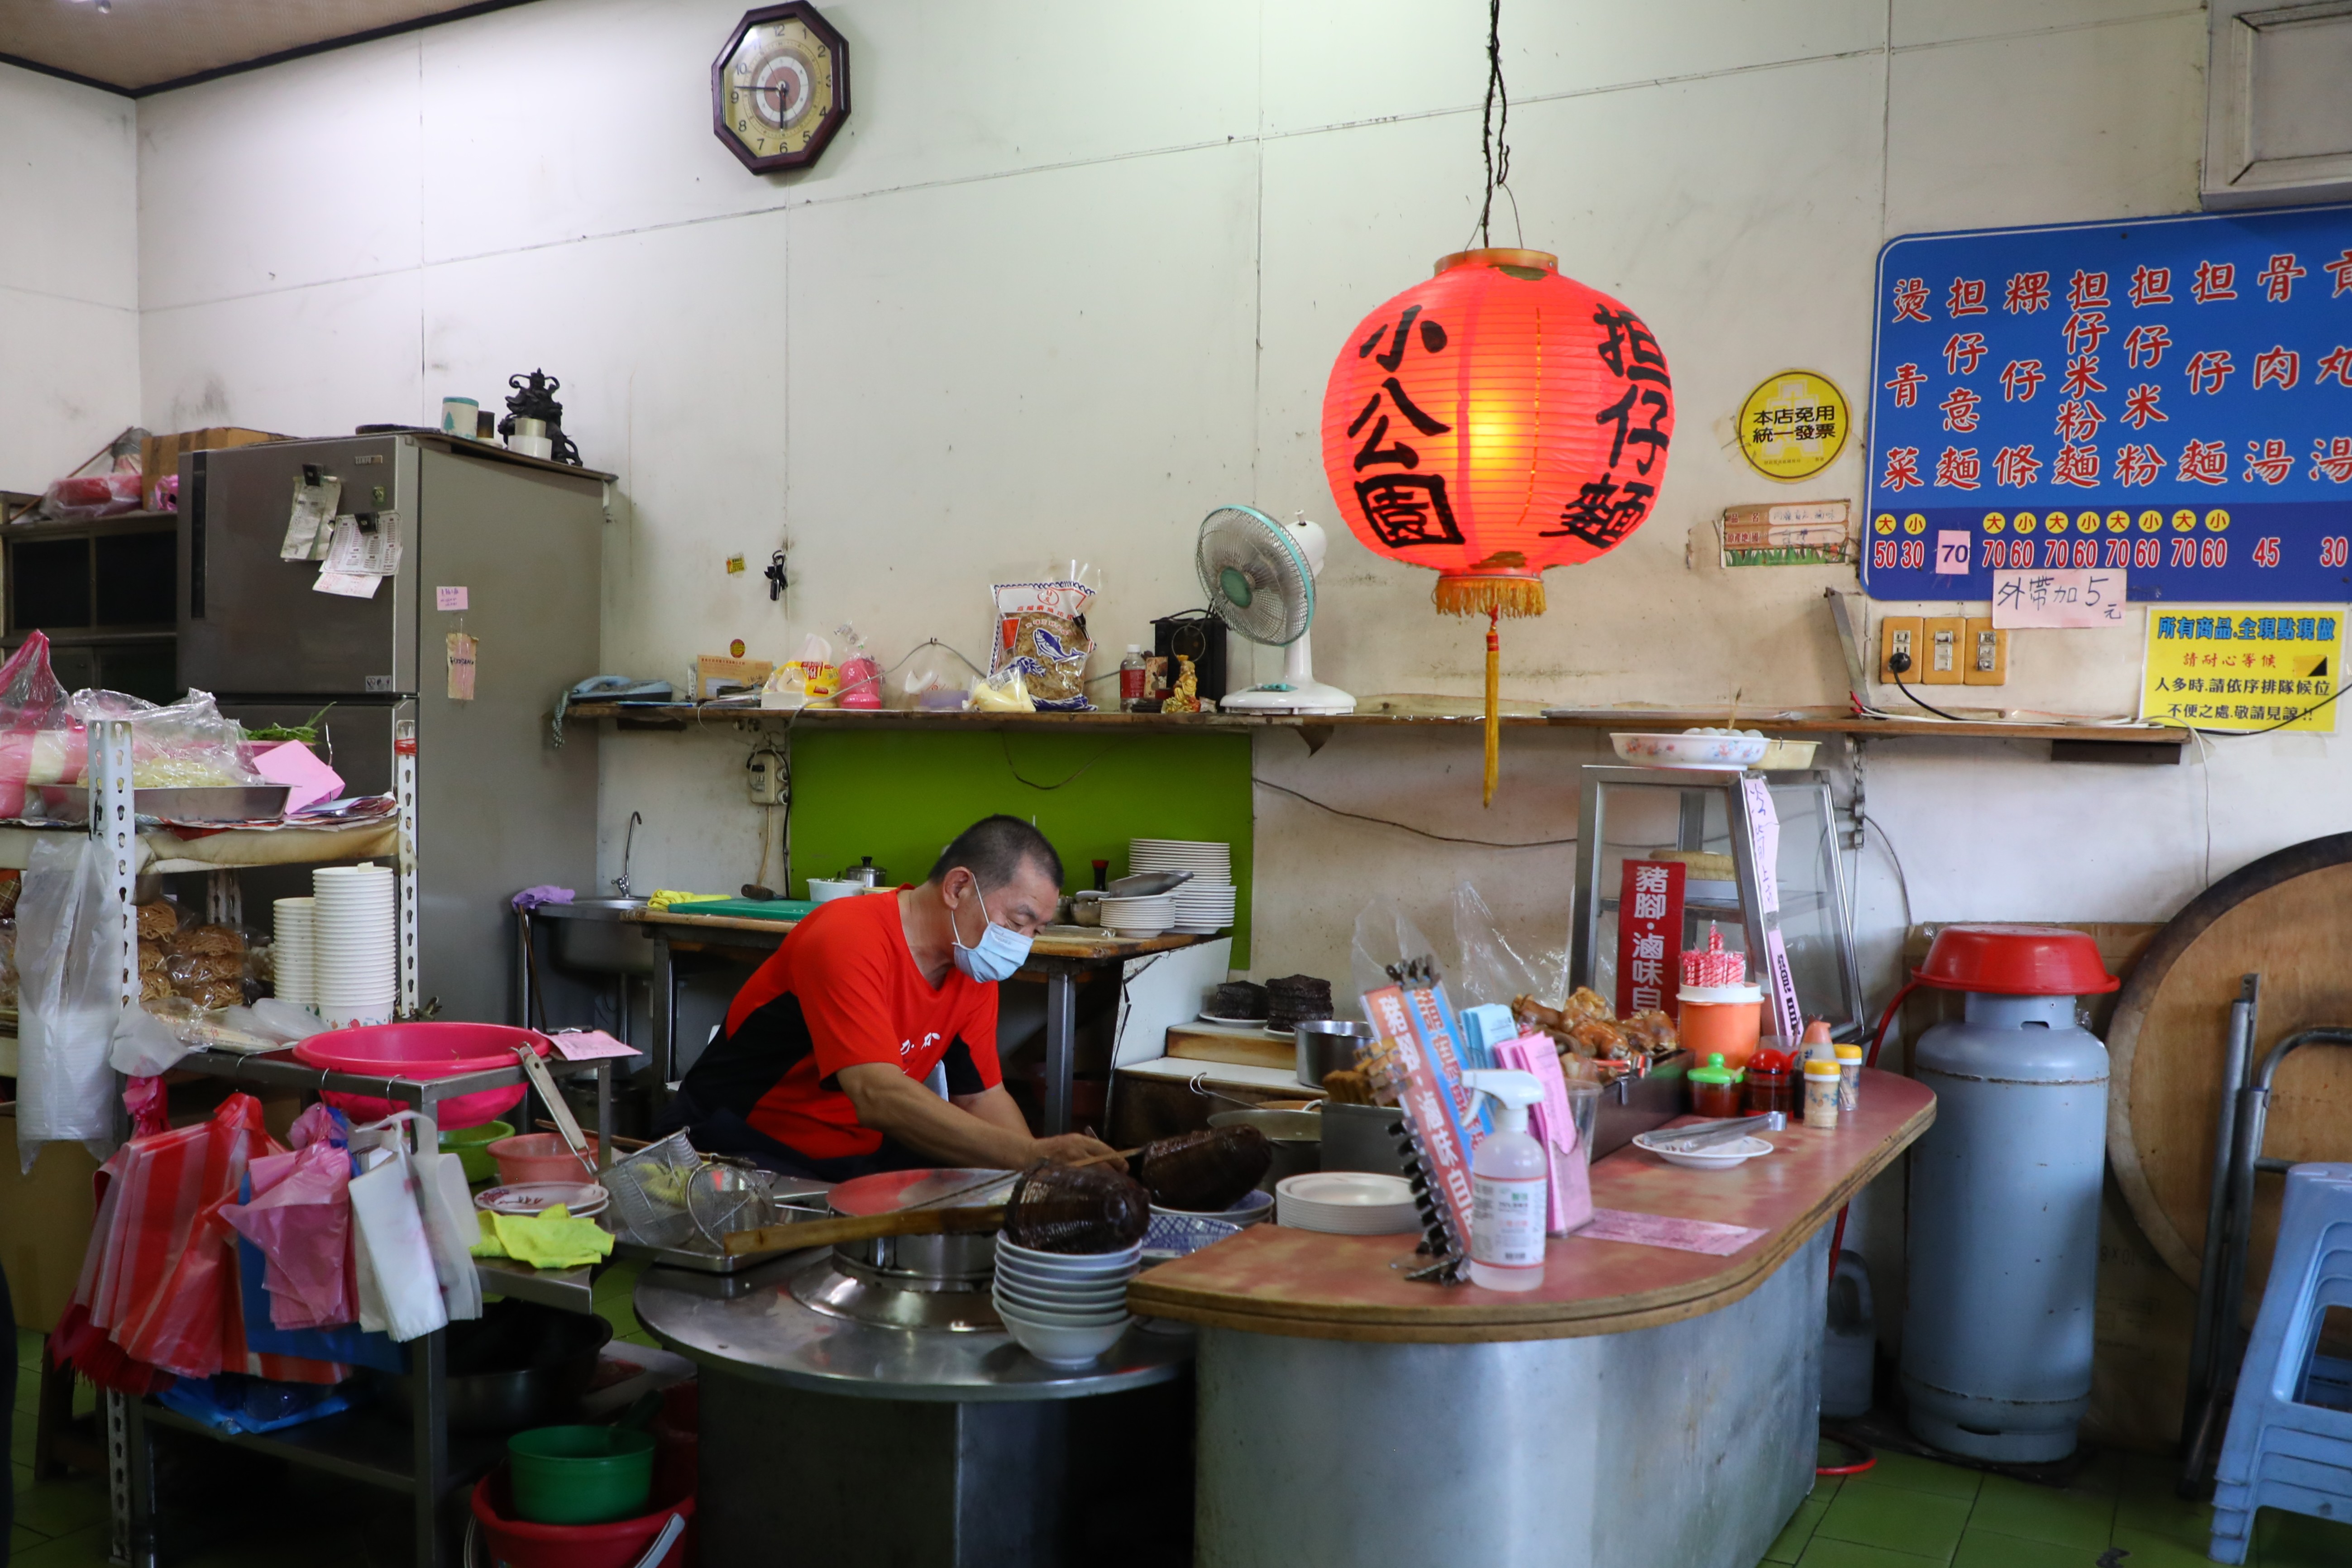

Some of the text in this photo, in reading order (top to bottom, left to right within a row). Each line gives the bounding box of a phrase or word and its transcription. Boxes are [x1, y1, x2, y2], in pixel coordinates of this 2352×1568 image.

[774, 24, 785, 37] 12
[803, 28, 807, 39] 1
[817, 46, 826, 58] 2
[736, 63, 747, 76] 10
[731, 91, 739, 104] 9
[819, 106, 827, 117] 4
[738, 120, 747, 132] 8
[757, 138, 765, 150] 7
[803, 130, 811, 143] 5
[779, 142, 788, 154] 6
[2113, 265, 2173, 488] 担仔米粉
[2176, 261, 2237, 485] 担仔麵
[2243, 254, 2306, 485] 骨肉湯
[1934, 277, 1988, 491] 担仔意麵
[1993, 272, 2051, 488] 粿仔條
[1753, 405, 1835, 425] 本店免用
[1348, 304, 1466, 549] 小公園
[1539, 303, 1672, 550] 担仔麵
[1752, 423, 1836, 443] 統一發票
[1878, 516, 1923, 532] 大 小
[1986, 515, 2034, 531] 大 小
[2049, 514, 2097, 530] 大 小
[2110, 514, 2159, 529] 大 小
[2176, 513, 2226, 529] 大 小
[1874, 540, 1924, 569] 50 30
[1942, 544, 1969, 563] 70
[1982, 540, 2034, 568] 70 60
[2044, 539, 2099, 568] 70 60
[2104, 539, 2160, 568] 70 60
[2171, 538, 2227, 567] 70 60
[2252, 537, 2280, 567] 45
[2320, 536, 2348, 567] 30
[2183, 652, 2276, 668] 請耐心等候
[1631, 866, 1669, 1015] 豬腳·滷味自
